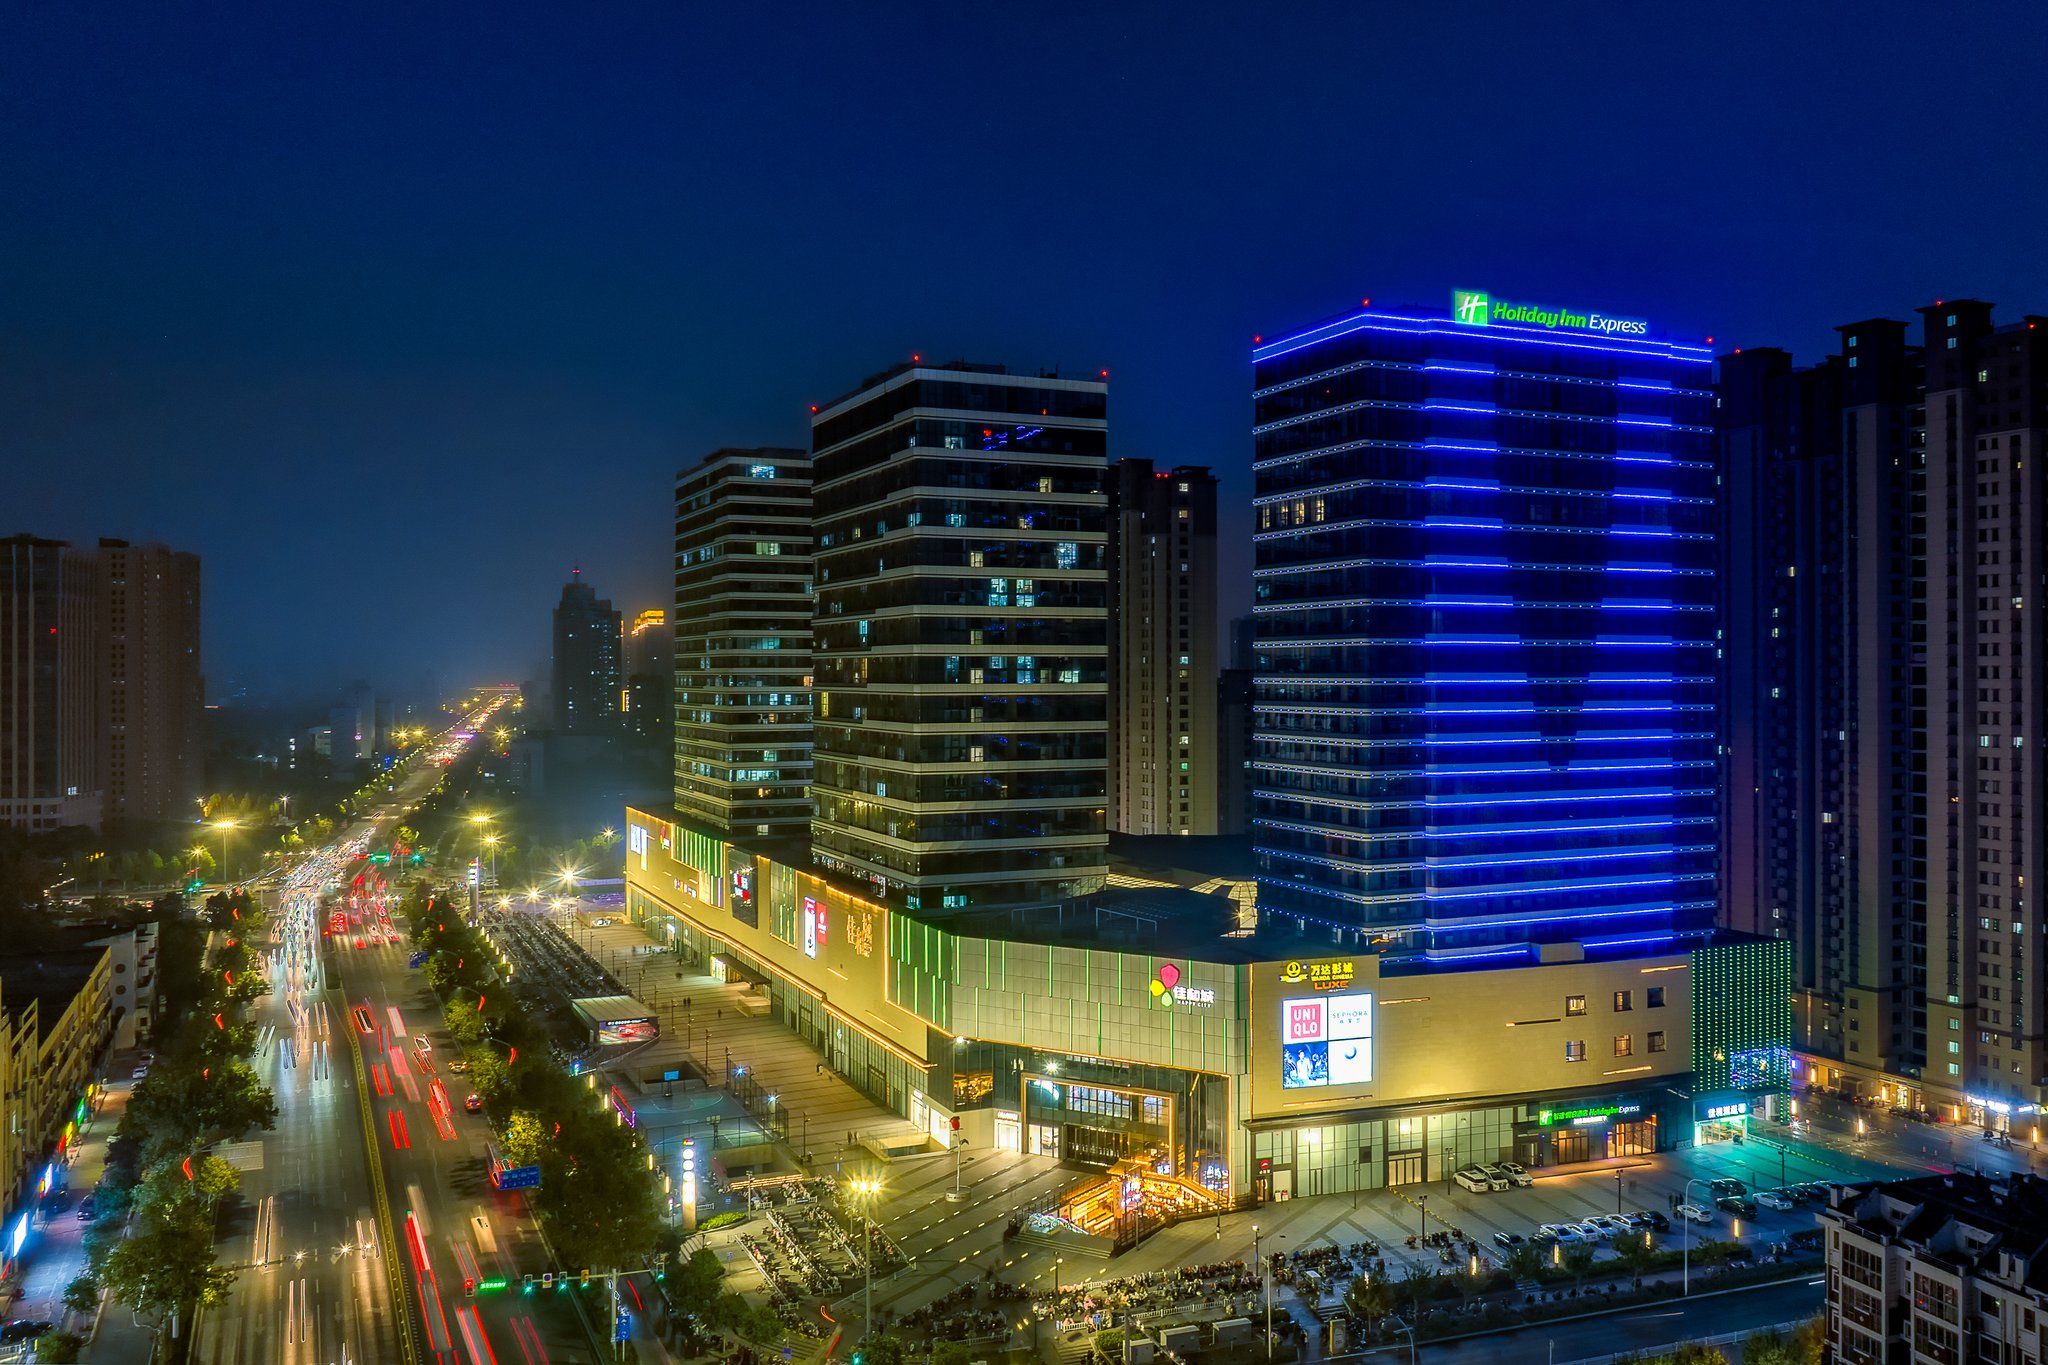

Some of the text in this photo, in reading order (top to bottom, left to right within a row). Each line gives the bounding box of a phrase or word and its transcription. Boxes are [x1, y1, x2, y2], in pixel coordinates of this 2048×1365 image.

[1493, 302, 1647, 334] Holiday Inn Express
[1314, 980, 1349, 990] LUXE
[1293, 1008, 1316, 1022] UNI
[1332, 1010, 1368, 1019] SEPHORA
[1293, 1021, 1318, 1037] QLO
[1619, 1105, 1640, 1114] Express
